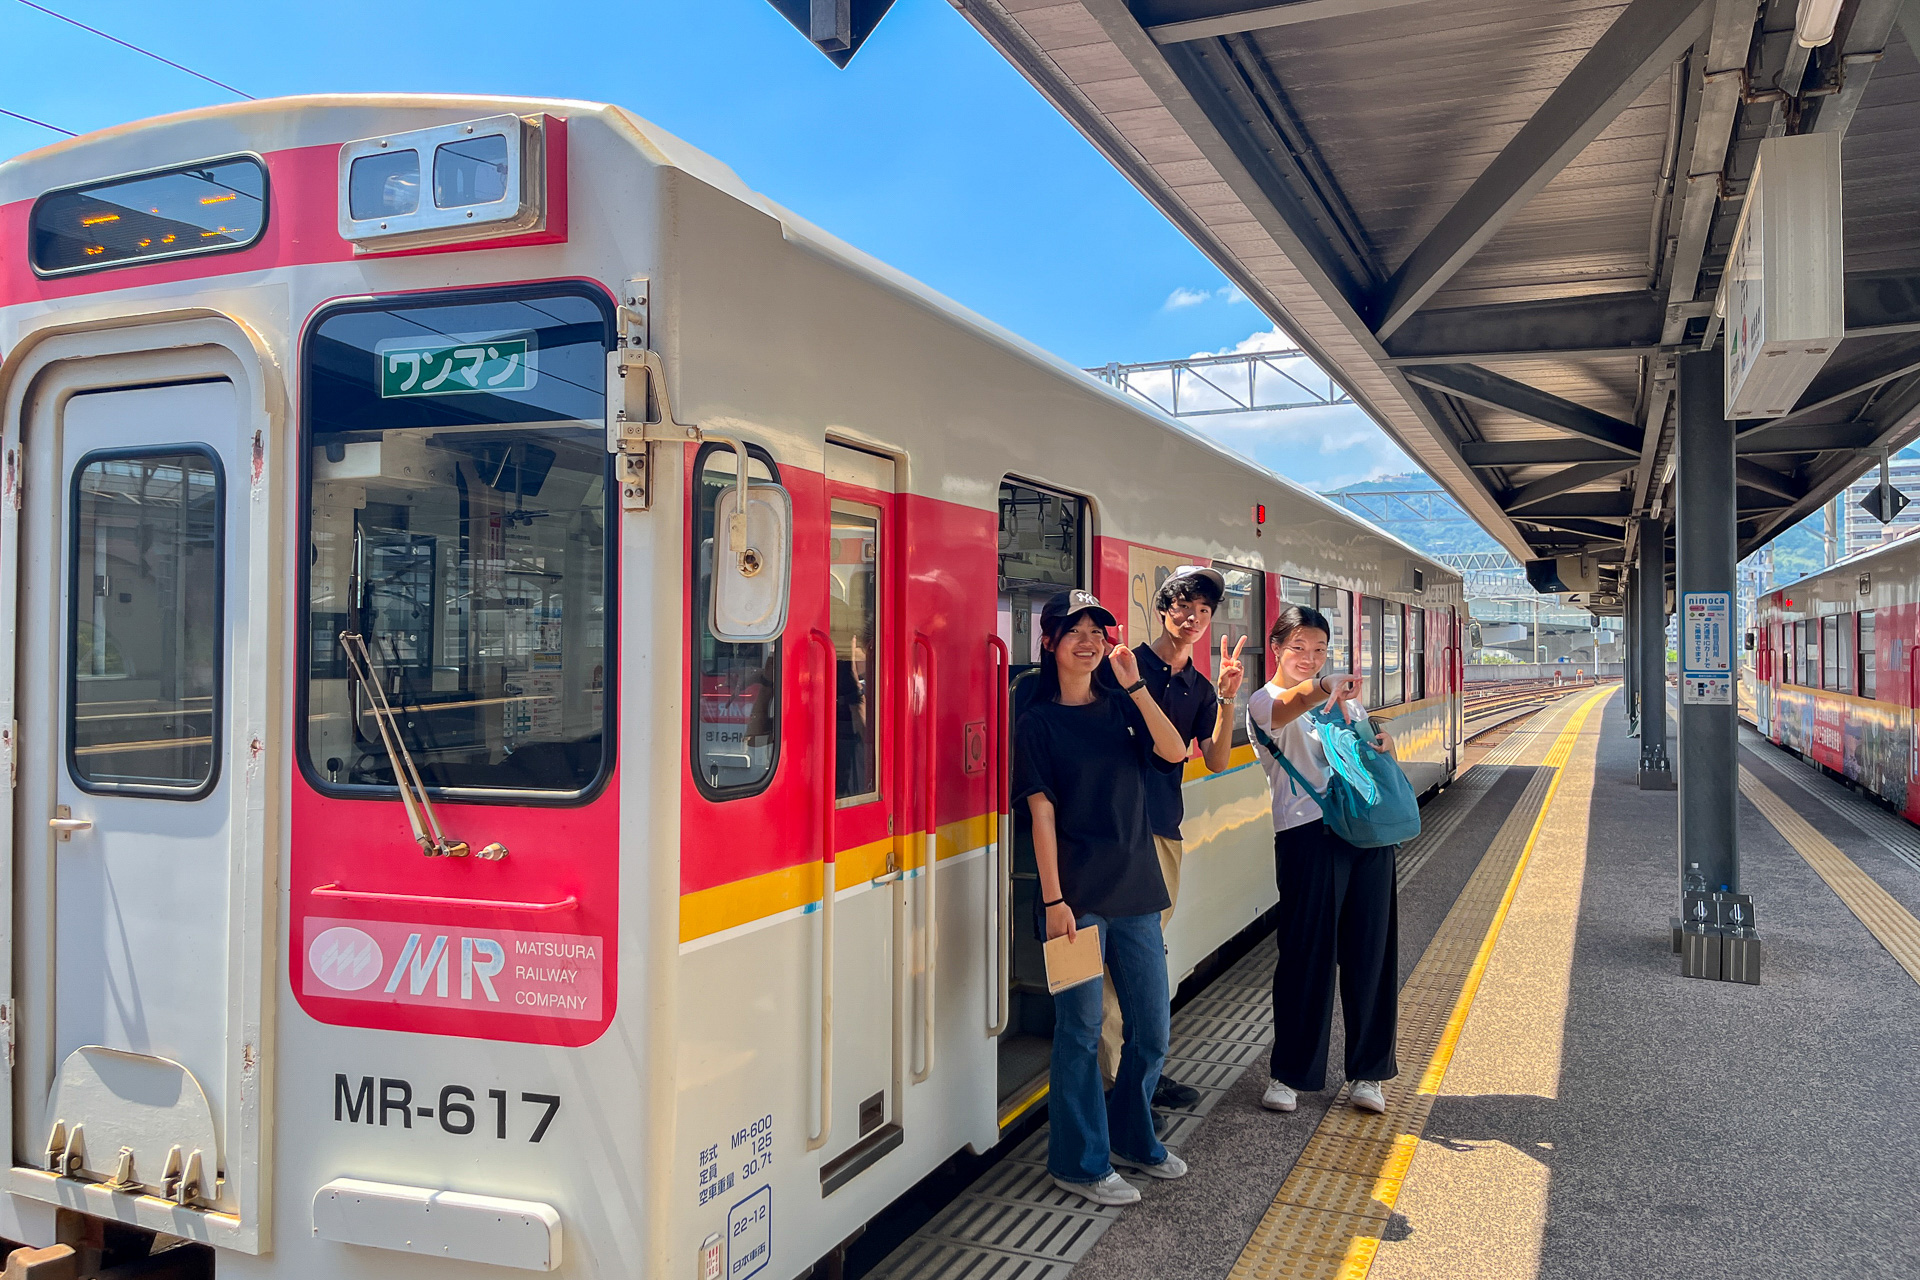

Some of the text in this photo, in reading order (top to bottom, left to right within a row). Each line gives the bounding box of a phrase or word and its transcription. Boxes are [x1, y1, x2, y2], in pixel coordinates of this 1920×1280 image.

[389, 346, 519, 392] ワンマン
[1688, 596, 1724, 604] nimoca
[383, 933, 505, 1002] MR
[515, 940, 596, 960] MATSUURA
[515, 966, 578, 984] RAILWAY
[515, 991, 588, 1011] COMPANY
[334, 1072, 561, 1143] MR-617
[699, 1114, 772, 1167] 形式 MR-600
[699, 1132, 772, 1187] 定員 125
[699, 1151, 772, 1207] 空車重量 30.7t
[733, 1204, 766, 1238] 22-12
